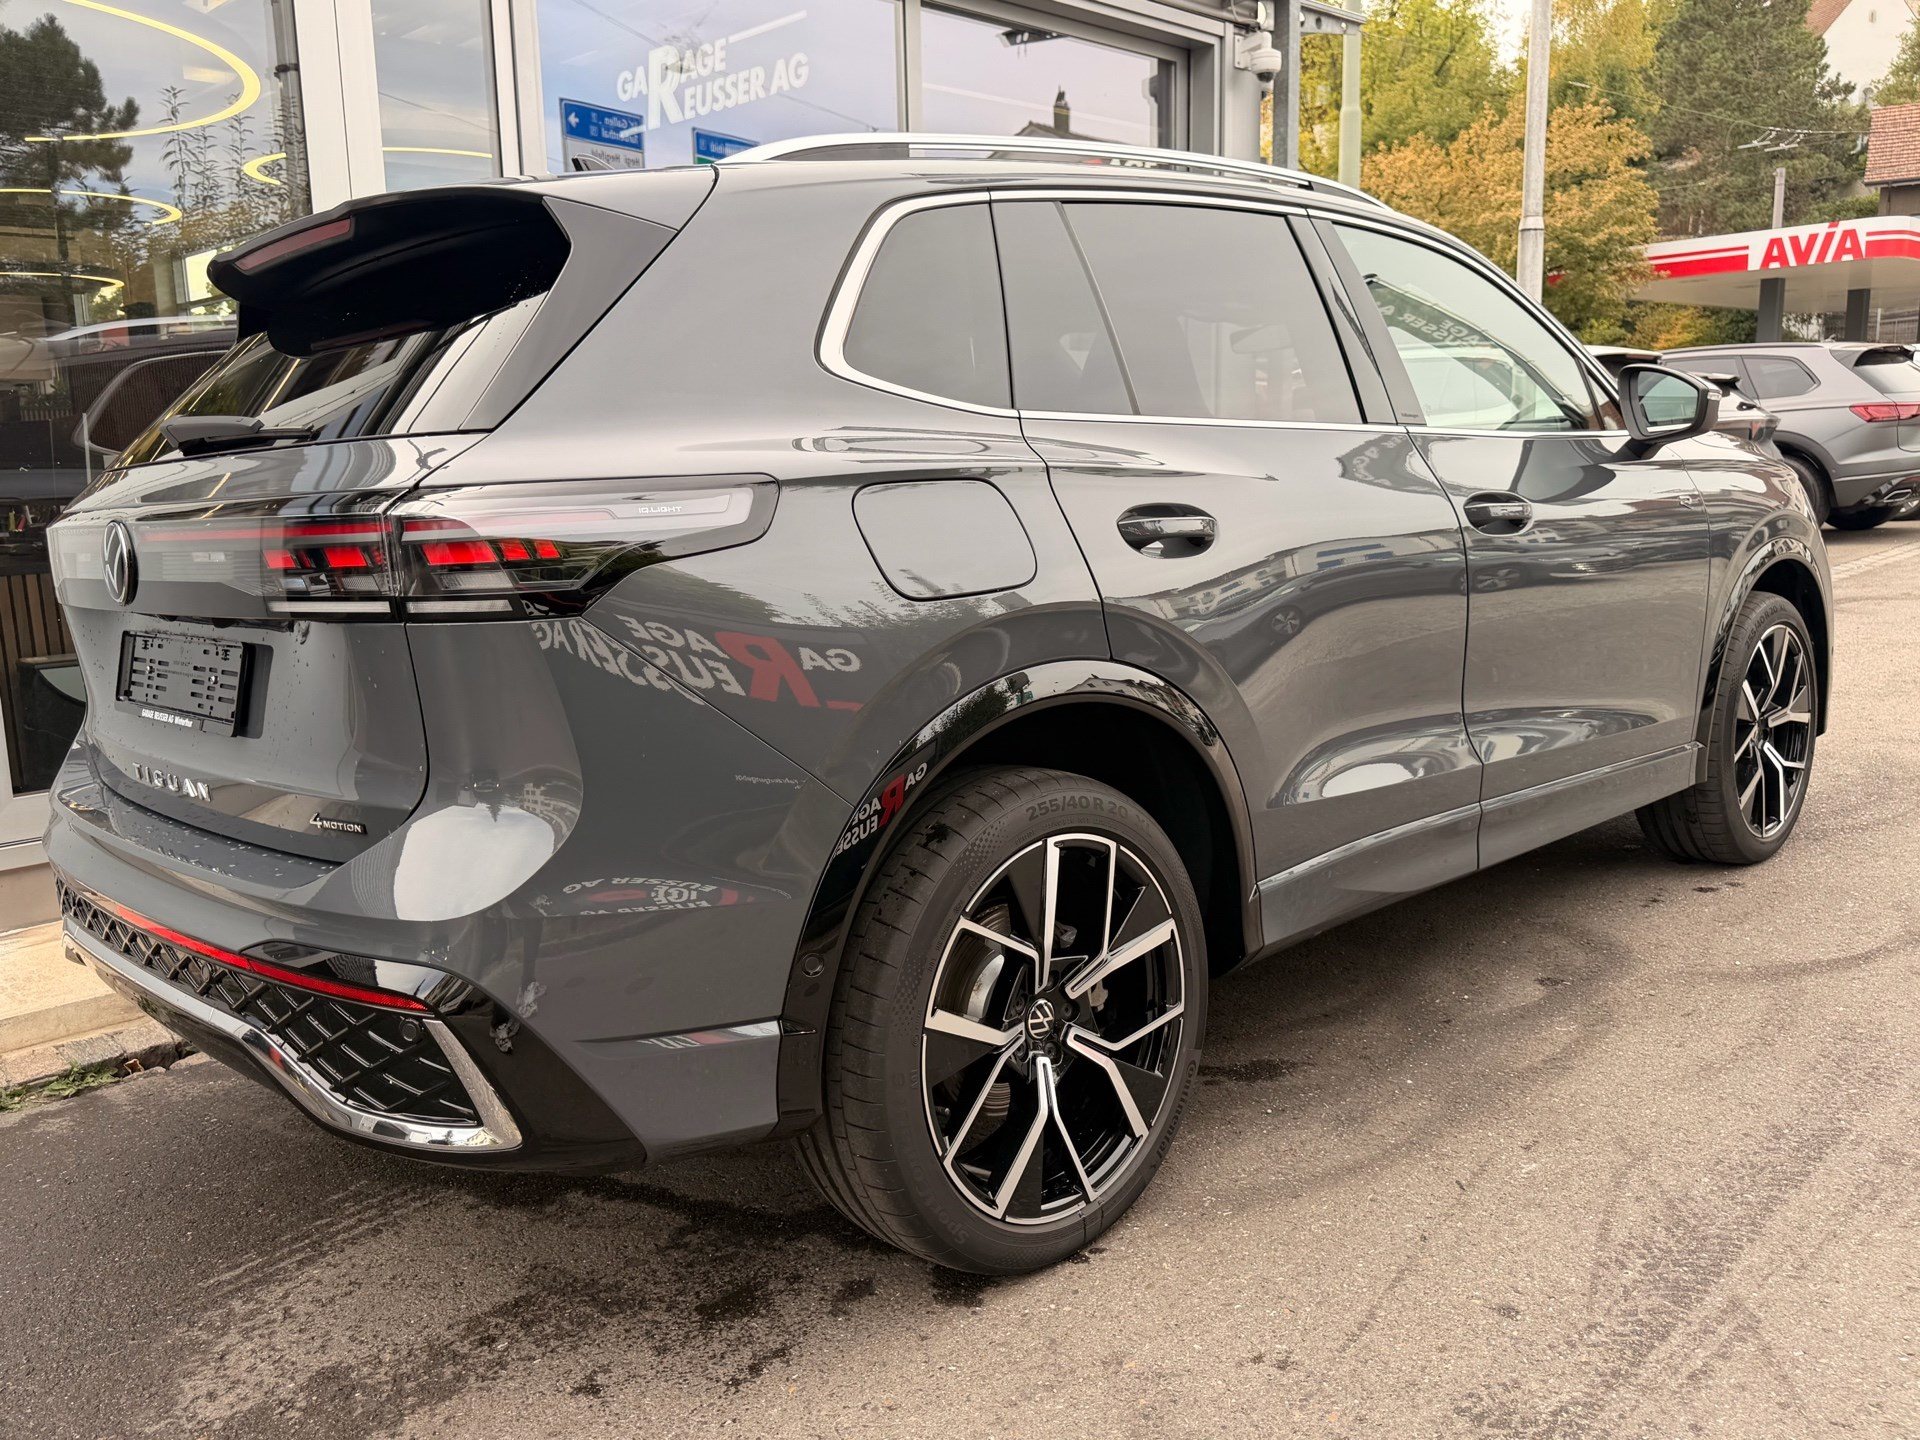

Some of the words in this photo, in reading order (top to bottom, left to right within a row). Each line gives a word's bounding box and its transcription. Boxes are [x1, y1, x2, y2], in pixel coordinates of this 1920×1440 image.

[617, 38, 727, 130] GARAGE
[769, 52, 809, 95] AG
[1759, 220, 1864, 270] AVIA
[638, 505, 682, 514] IQ.LIGHT
[133, 762, 211, 802] TIGUAN
[1026, 796, 1090, 822] 255/40
[1093, 798, 1105, 812] R
[1107, 802, 1129, 819] 20
